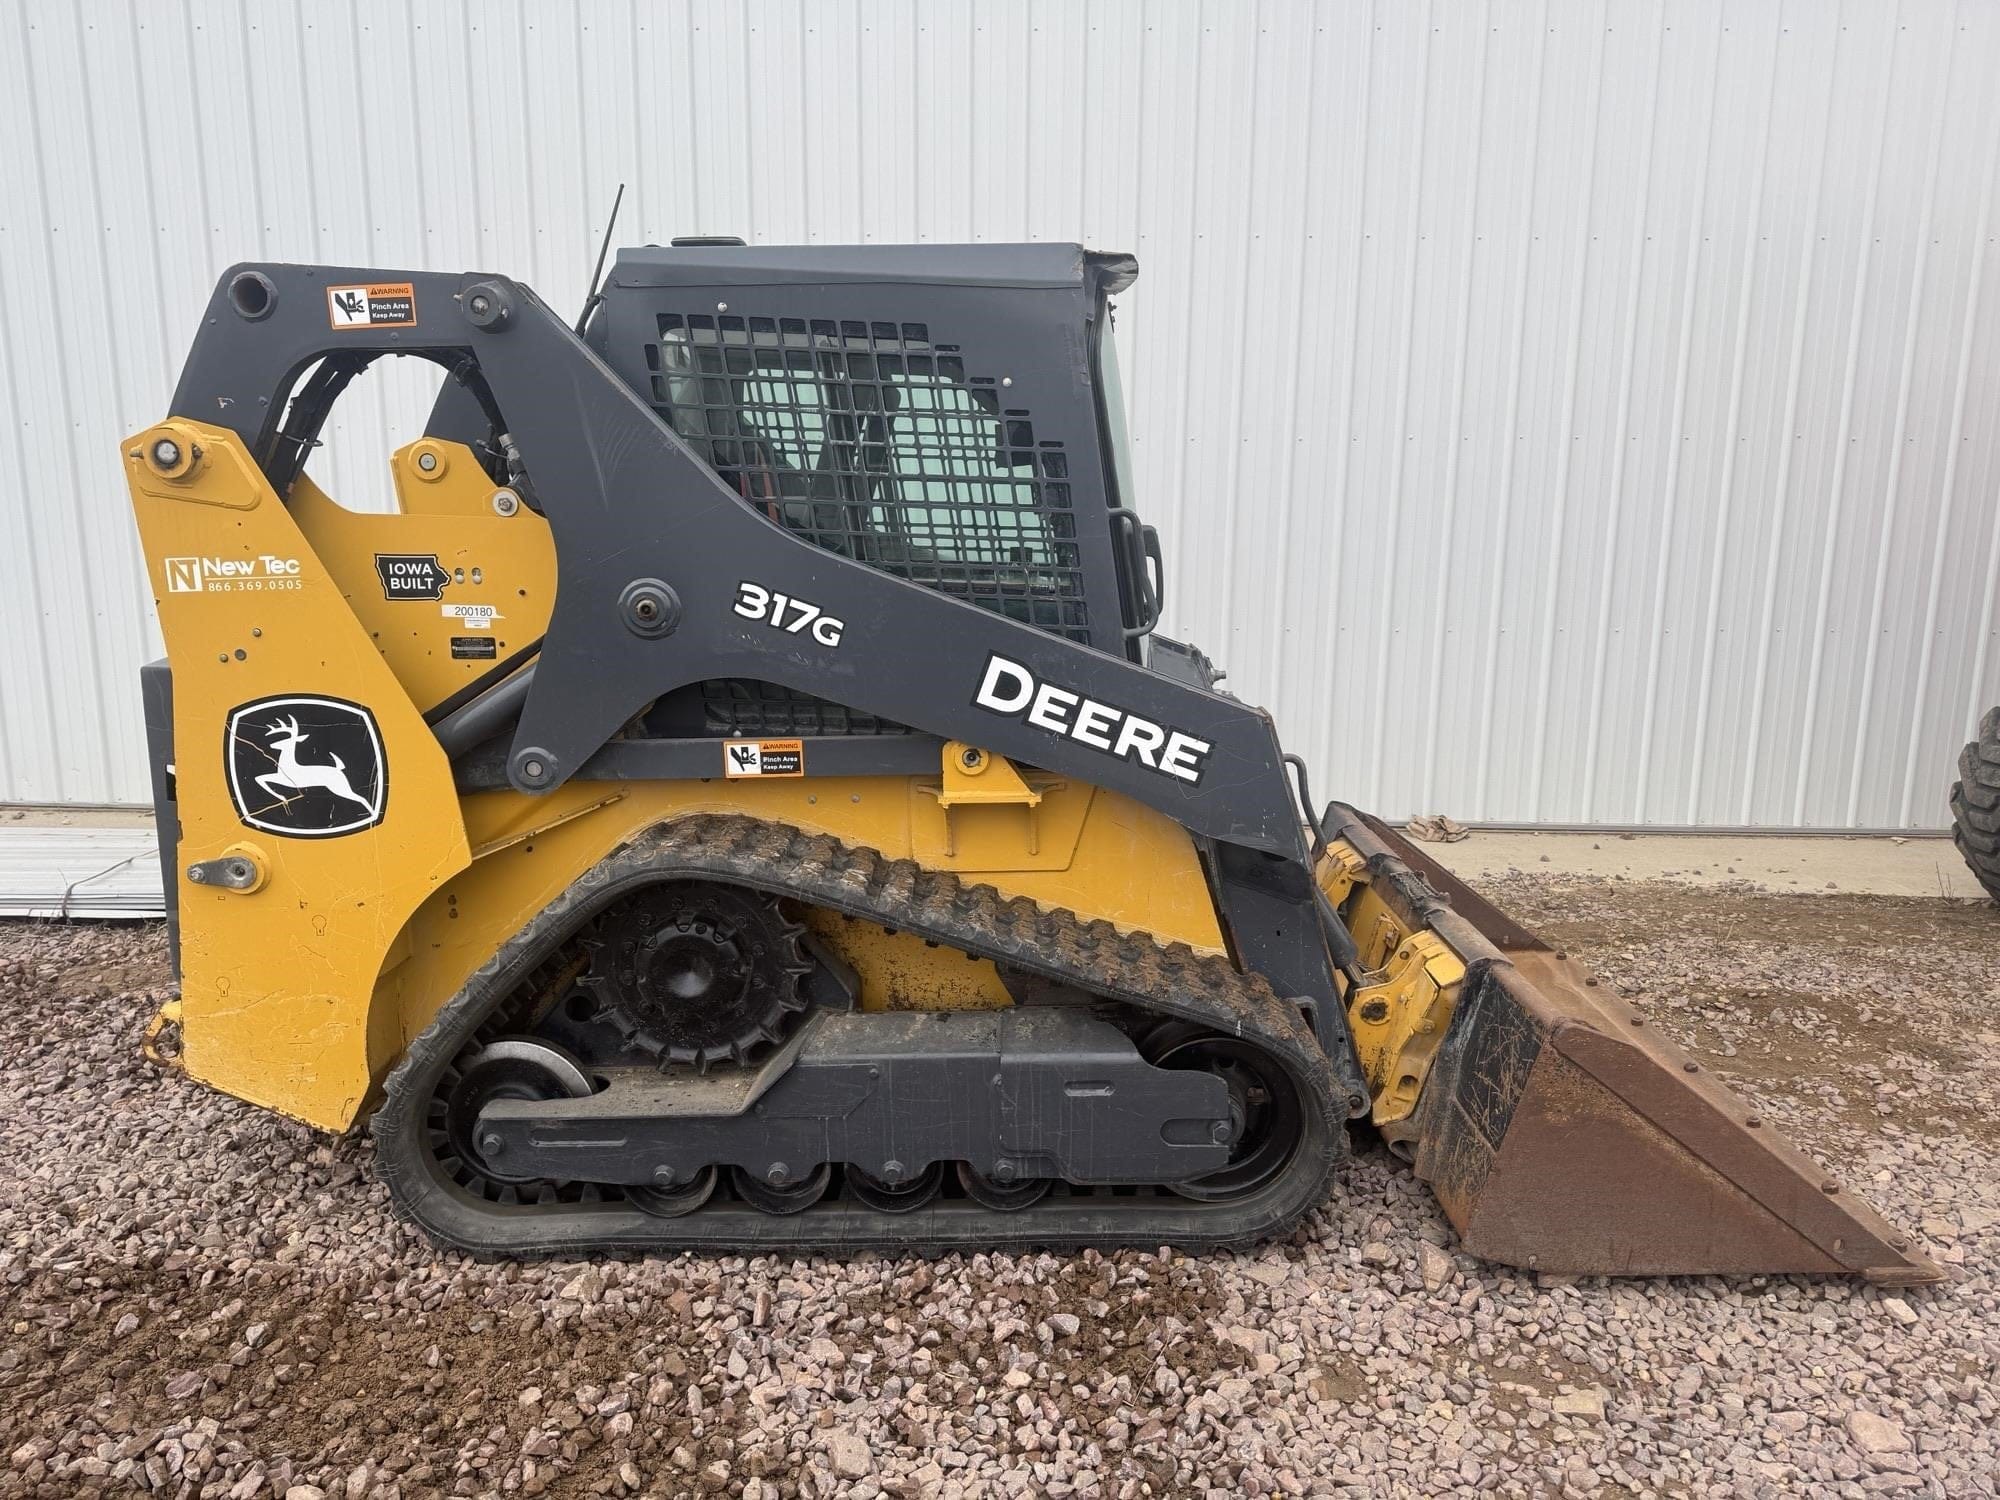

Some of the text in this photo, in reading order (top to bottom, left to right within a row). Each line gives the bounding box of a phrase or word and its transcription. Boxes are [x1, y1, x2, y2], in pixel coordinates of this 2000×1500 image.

[376, 287, 409, 295] WARNING
[202, 555, 301, 576] New Tec
[388, 563, 433, 575] IOWA
[208, 580, 302, 592] 866.369.0505
[390, 577, 434, 590] BUILT
[454, 606, 493, 617] 200180
[734, 583, 845, 647] 317G
[976, 655, 1211, 782] DEERE
